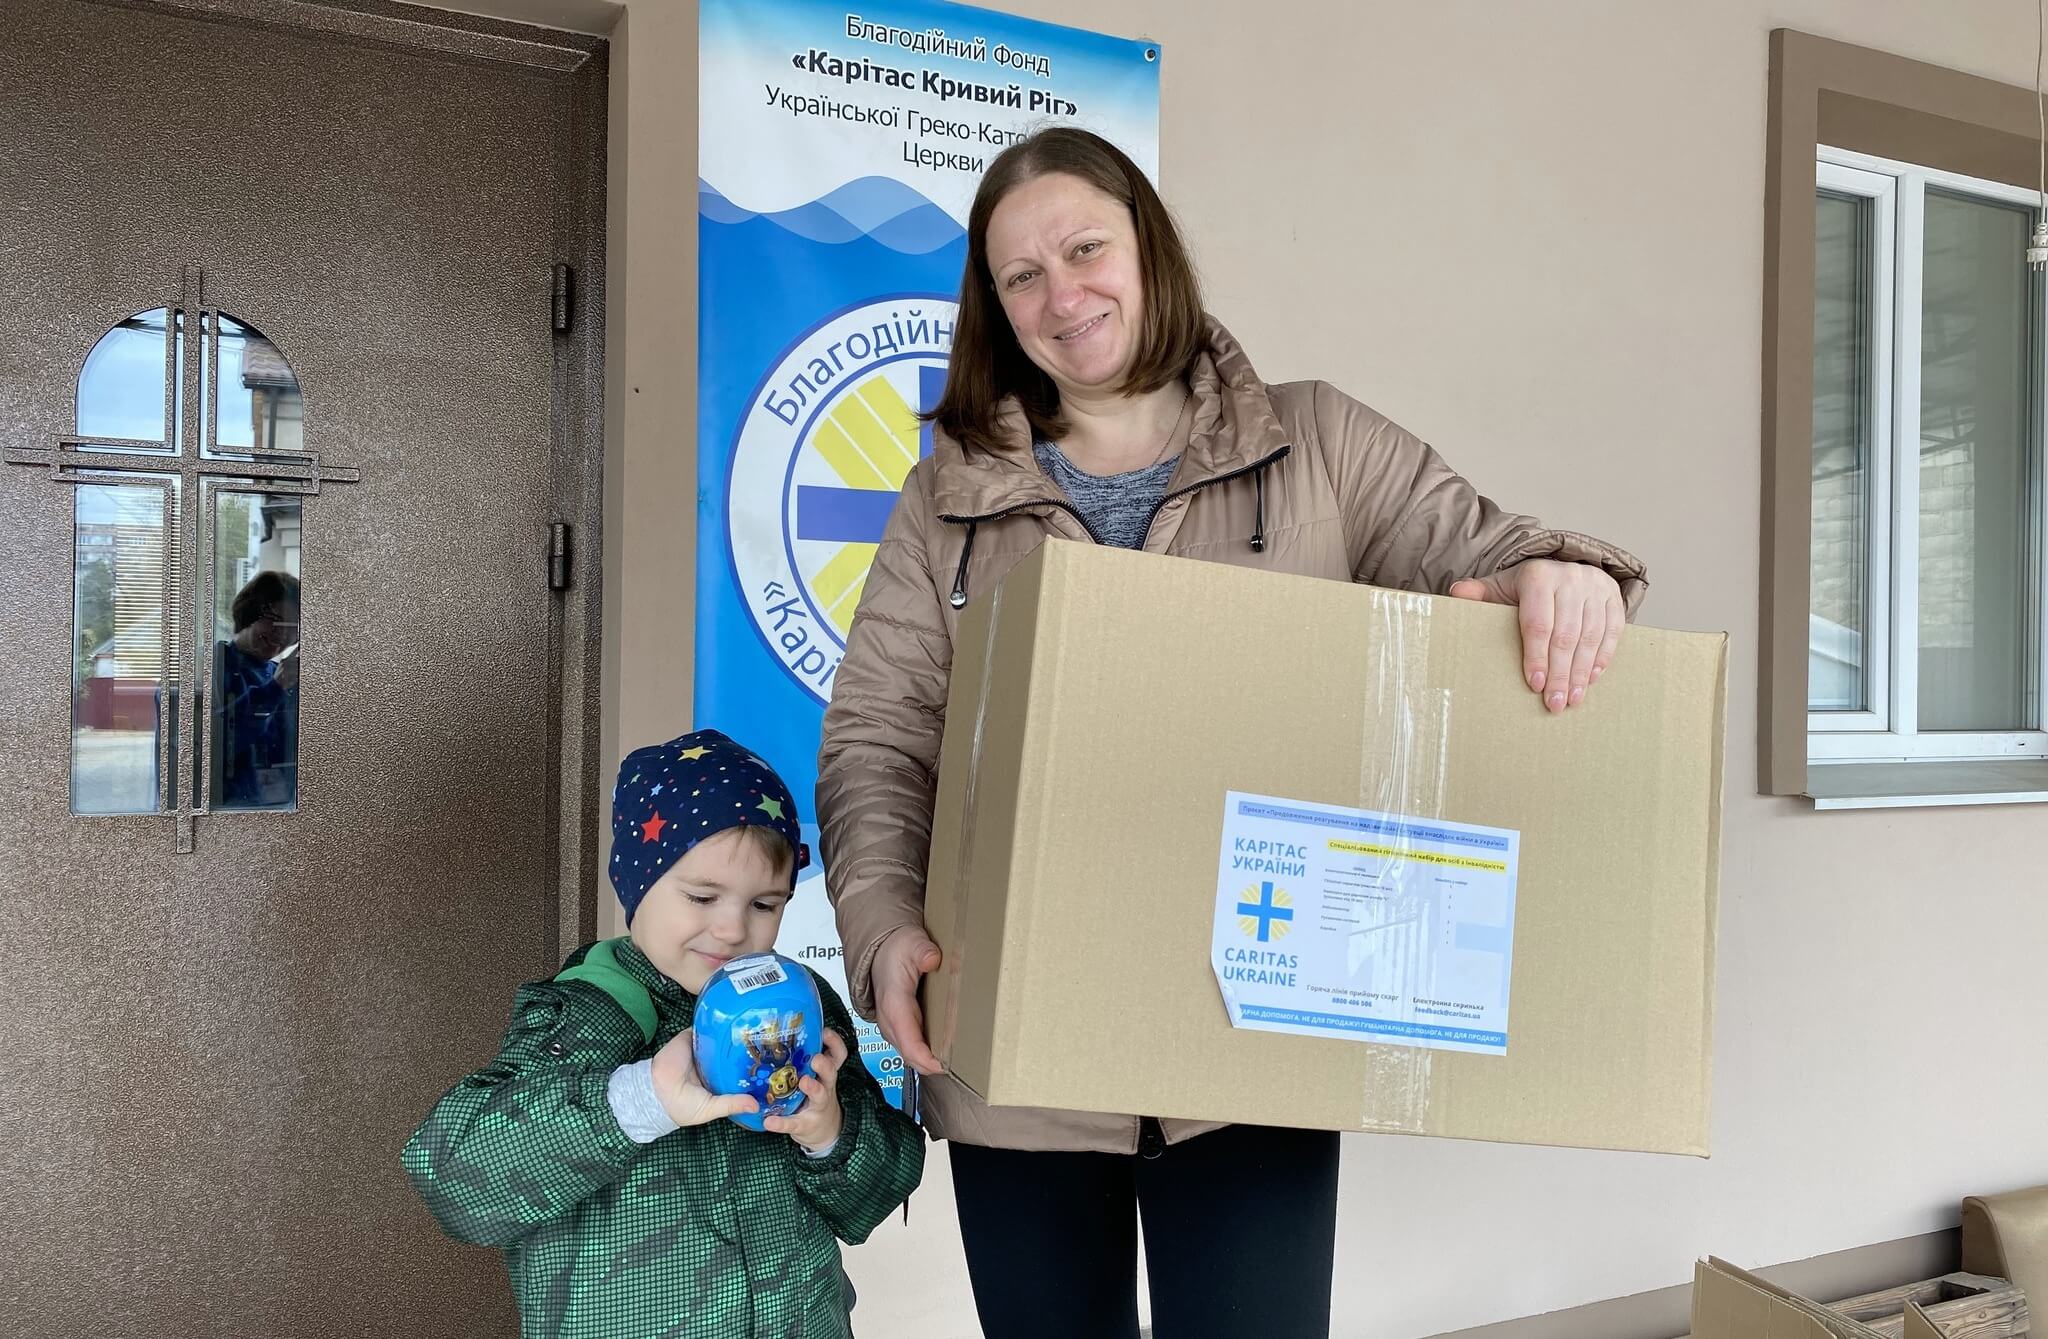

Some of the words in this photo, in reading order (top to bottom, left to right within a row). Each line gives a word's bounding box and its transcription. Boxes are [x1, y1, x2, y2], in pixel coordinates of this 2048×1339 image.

[846, 15, 985, 62] Благодійний
[993, 44, 1051, 77] Фонд
[792, 49, 916, 90] «Карітас
[922, 70, 1021, 109] Кривий
[1029, 90, 1078, 116] Ріг»
[765, 84, 900, 127] Української
[907, 109, 1028, 147] Греко-Като
[903, 140, 984, 173] Церкви
[763, 309, 954, 427] Благодійн
[763, 581, 842, 687] «Карі
[1235, 837, 1308, 860] КАРІТАС
[1232, 855, 1306, 878] УКРАЇНИ
[798, 945, 845, 960] «Пара
[1225, 947, 1299, 969] CARITAS
[1223, 966, 1297, 988] UKRAINE
[880, 1056, 904, 1072] 09
[878, 1075, 904, 1089] s.kry
